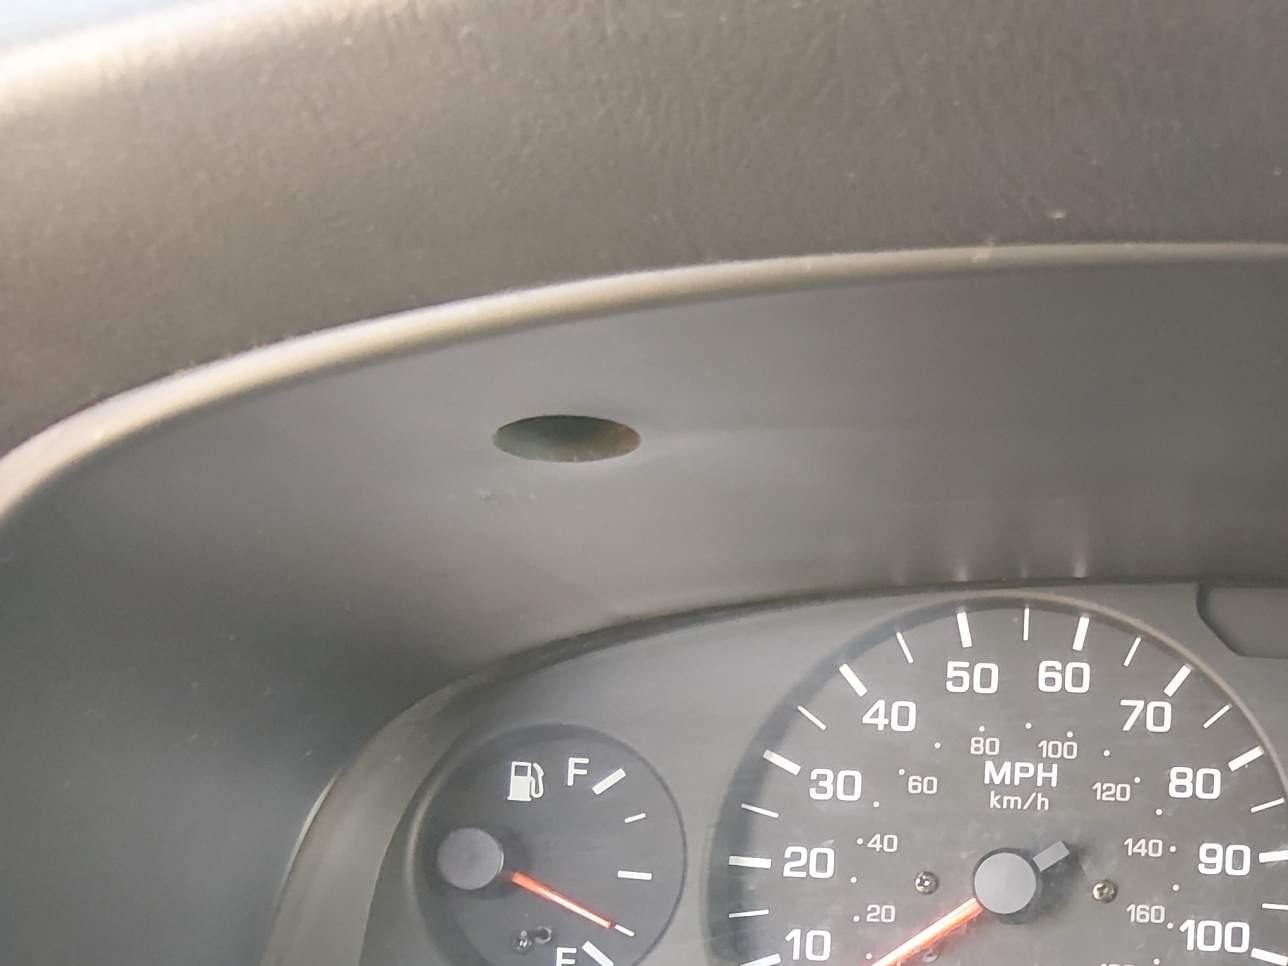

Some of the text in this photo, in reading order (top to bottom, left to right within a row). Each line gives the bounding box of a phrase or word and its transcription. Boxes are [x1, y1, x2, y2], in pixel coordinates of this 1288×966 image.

[946, 662, 999, 694] 50
[1038, 662, 1090, 694] 60
[862, 700, 916, 732] 40
[1120, 699, 1172, 732] 70
[970, 737, 1000, 756] 80
[1038, 740, 1078, 760] 100
[567, 758, 589, 786] F
[809, 769, 861, 801] 30
[907, 776, 938, 795] 60
[983, 761, 1058, 787] MPH
[1168, 767, 1222, 800] 80
[989, 791, 1050, 811] km/h
[1092, 783, 1131, 802] 120
[867, 834, 898, 852] 40
[1124, 839, 1163, 858] 140
[782, 846, 835, 879] 20
[1197, 843, 1251, 875] 90
[866, 904, 895, 923] 20
[1126, 905, 1165, 924] 160
[785, 928, 832, 962] 10
[1179, 920, 1250, 953] 100
